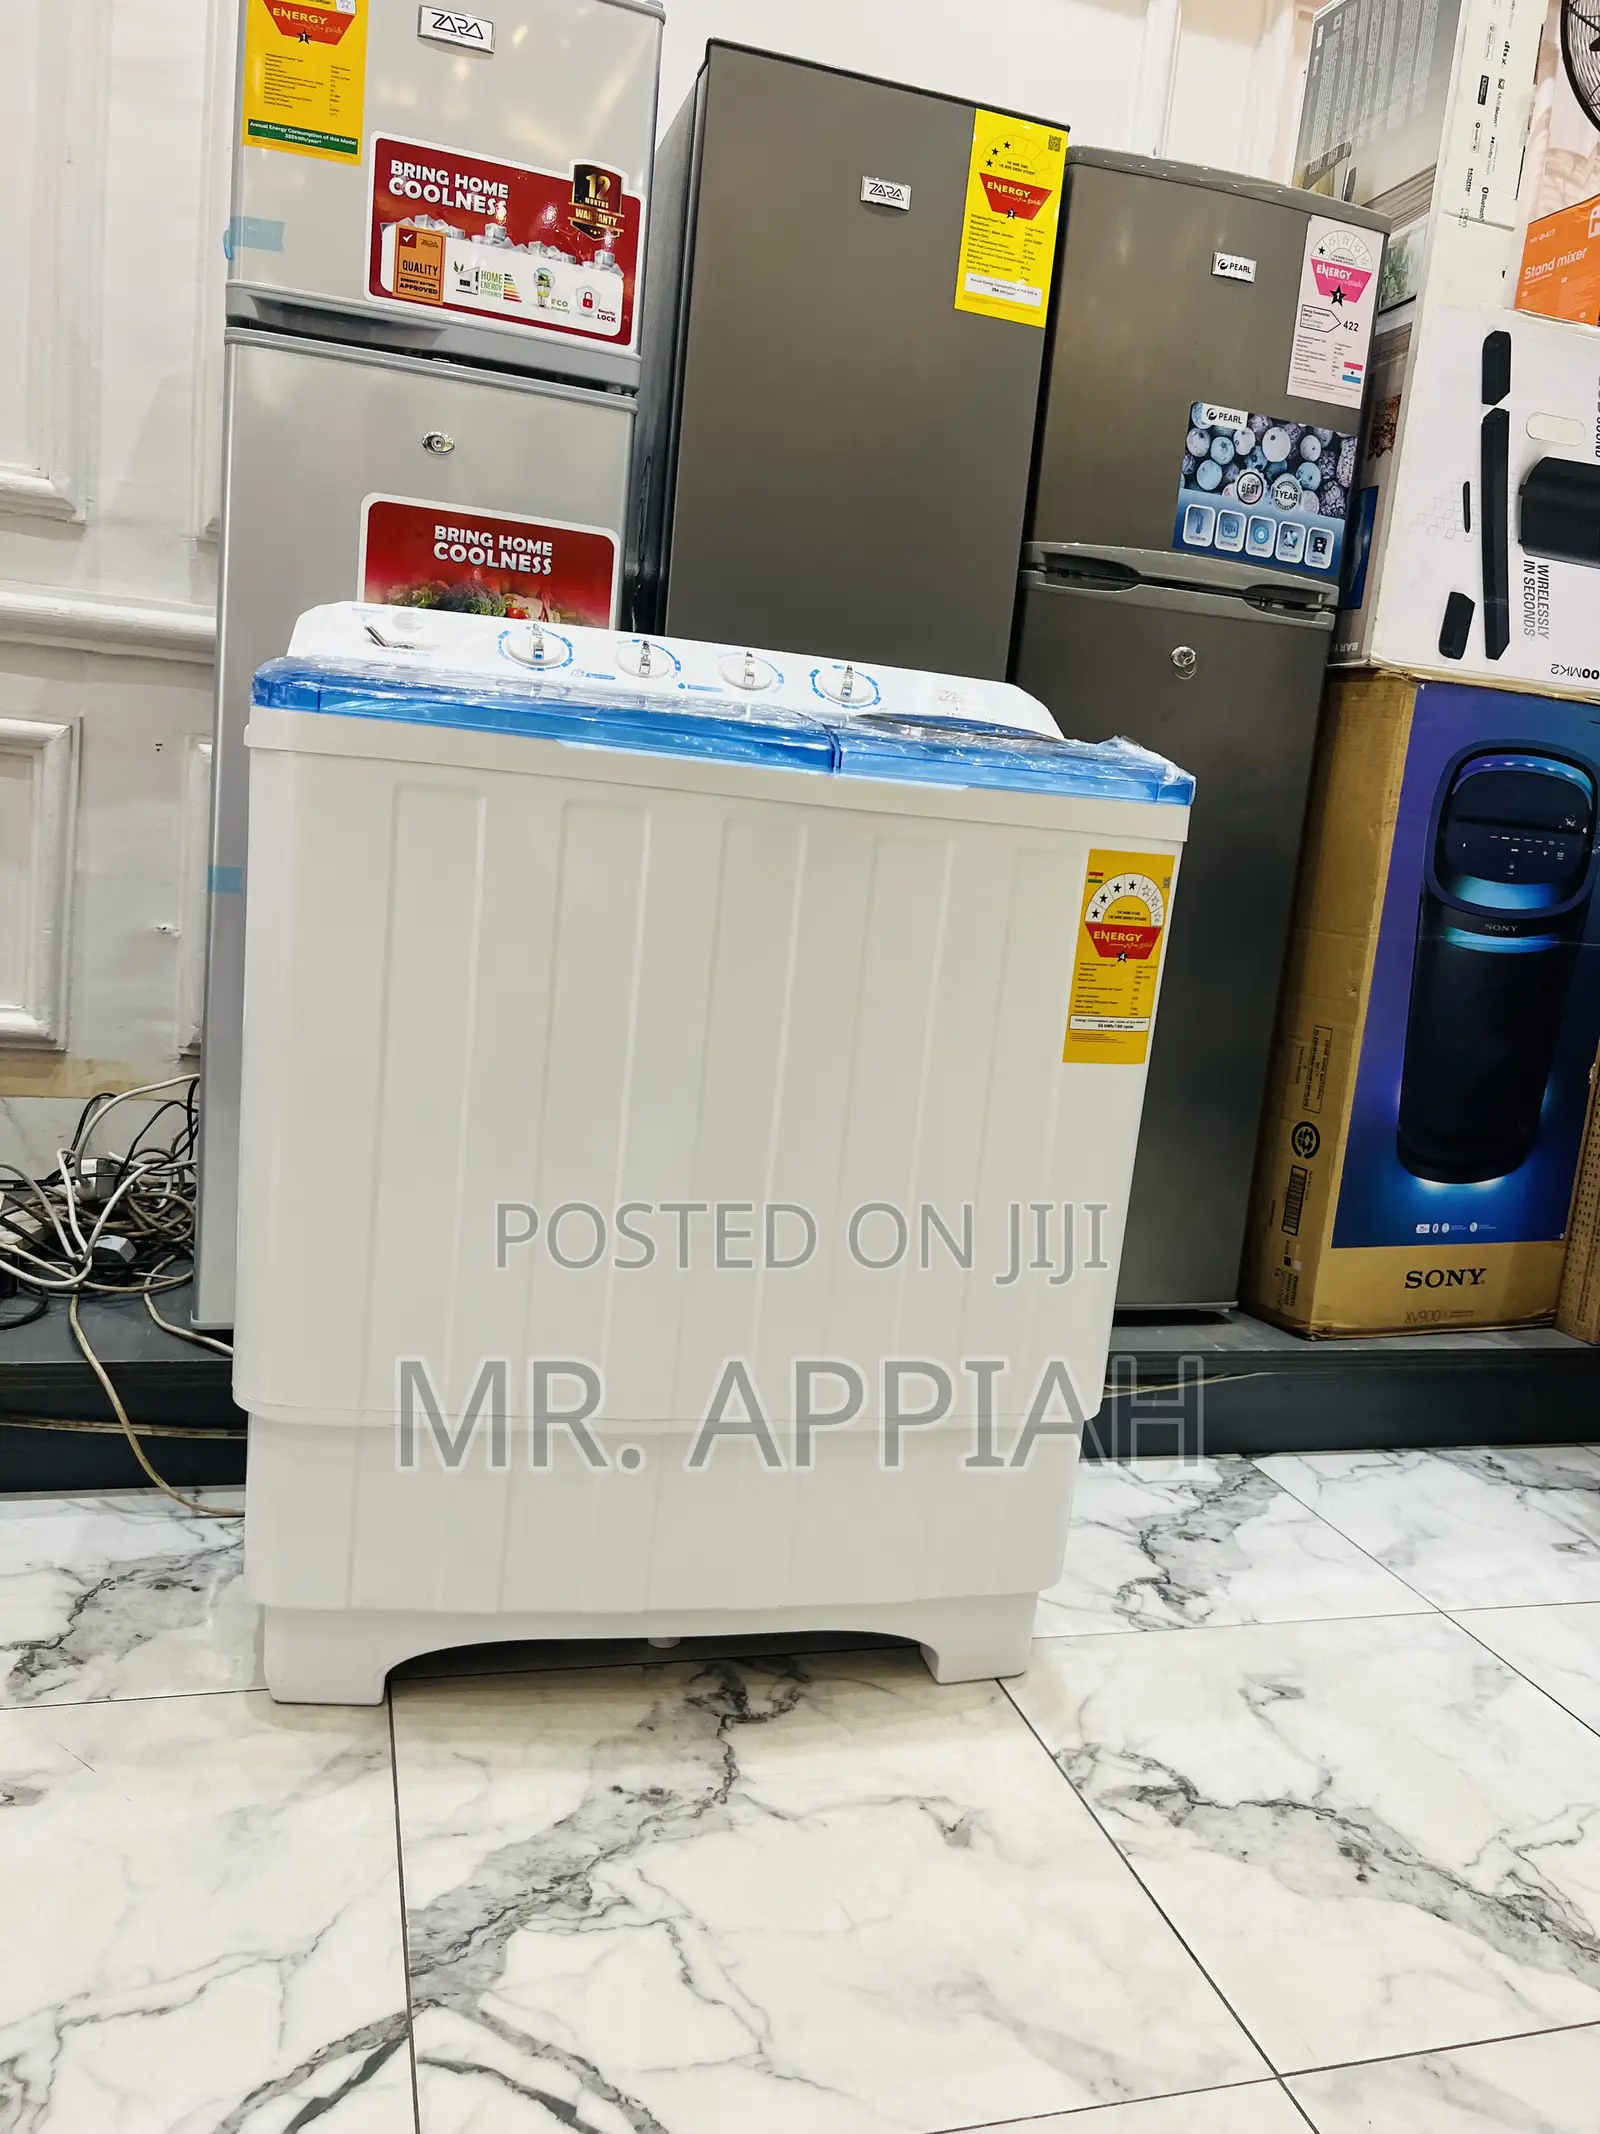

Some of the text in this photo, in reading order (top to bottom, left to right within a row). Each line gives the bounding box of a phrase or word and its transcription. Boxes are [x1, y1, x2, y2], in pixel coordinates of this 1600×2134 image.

[273, 7, 328, 25] ENERGY
[431, 12, 484, 40] ZARA
[250, 121, 268, 130] Annual
[269, 125, 287, 133] Energy
[288, 128, 322, 140] Consumption
[391, 159, 509, 200] BRING HOME
[585, 173, 612, 202] 12
[389, 177, 508, 218] COOLNESS
[869, 182, 904, 202] ZARA
[987, 181, 1031, 198] ENERGY
[584, 196, 609, 210] MONTHS
[402, 260, 438, 277] QUALITY
[1229, 262, 1252, 275] PEARL
[1316, 262, 1352, 281] ENERGY
[1524, 248, 1588, 281] Stand mixer
[480, 270, 504, 284] HOME
[399, 282, 438, 296] APPROVED
[480, 281, 504, 293] ENERGY
[551, 298, 569, 308] ECO
[597, 313, 616, 324] LOCK
[1343, 320, 1359, 332] 422
[1218, 412, 1242, 425] PEARL
[1241, 484, 1260, 496] BEST
[434, 525, 553, 557] BRING HOME
[433, 542, 552, 576] COOLNESS
[1523, 560, 1536, 637] IN SECONDS
[1537, 564, 1550, 640] WIRELESSLY
[1484, 923, 1518, 932] SONY
[1093, 930, 1144, 944] ENERGY
[1404, 1268, 1487, 1290] SONY
